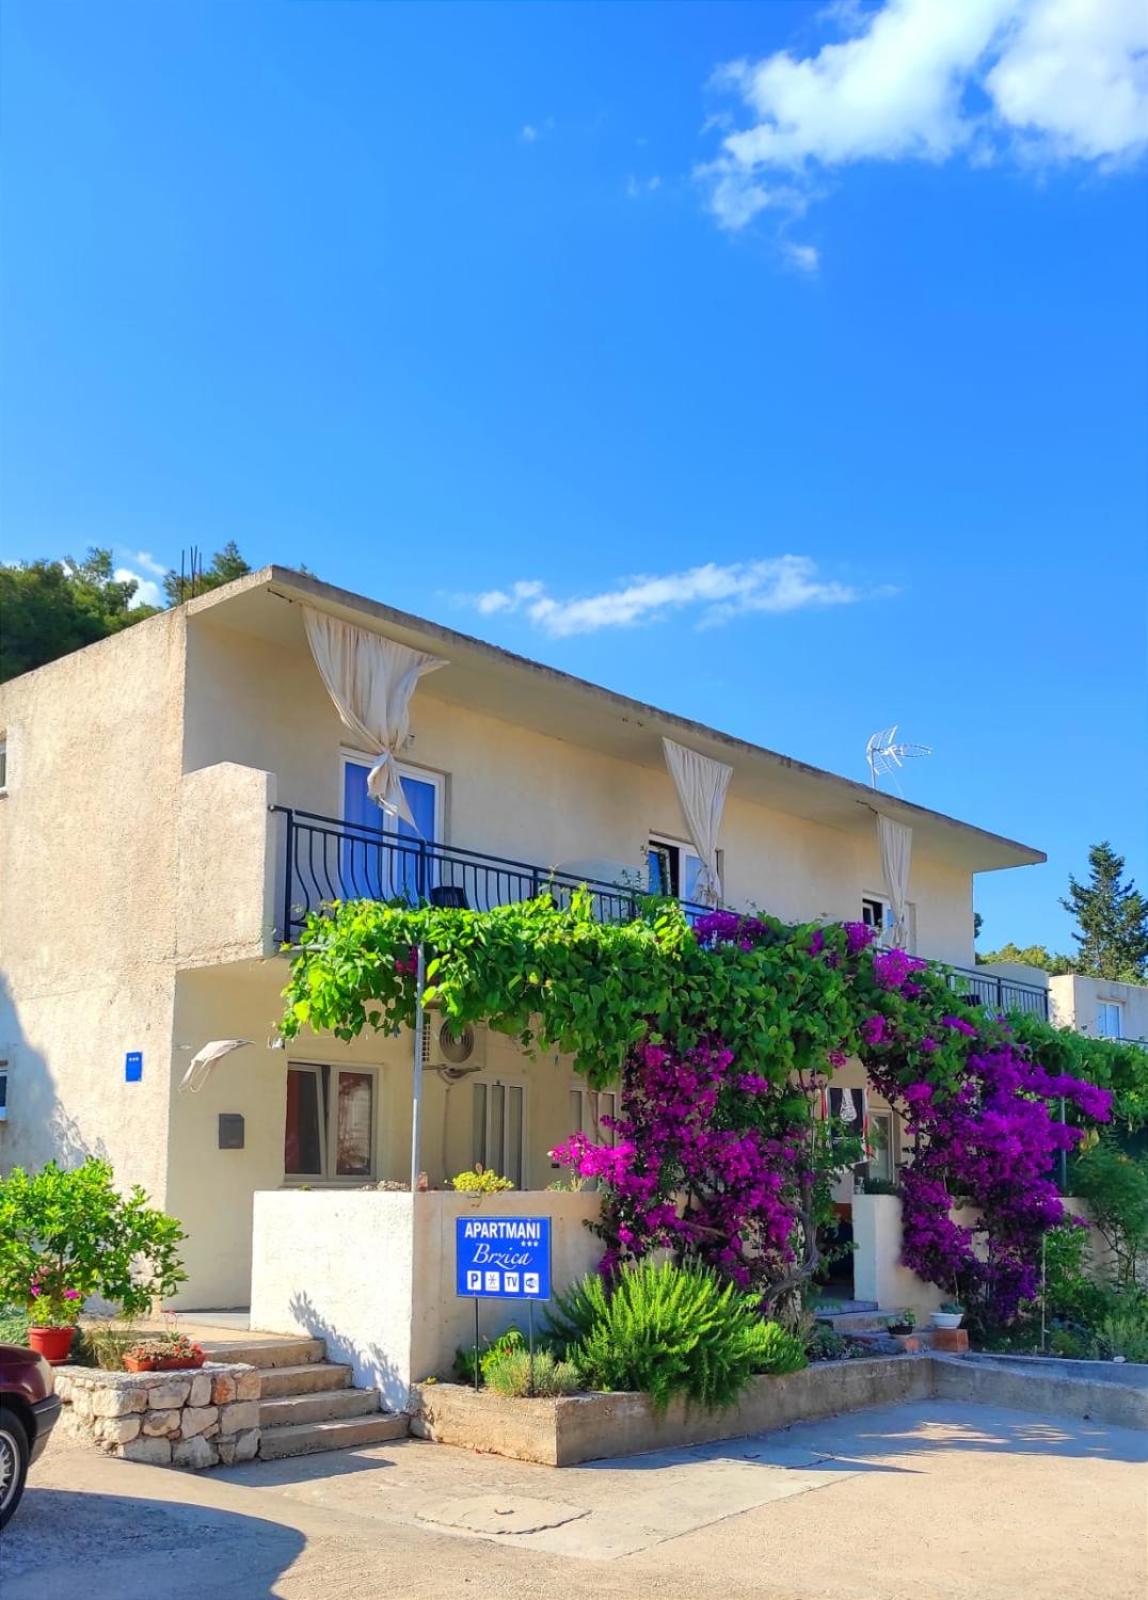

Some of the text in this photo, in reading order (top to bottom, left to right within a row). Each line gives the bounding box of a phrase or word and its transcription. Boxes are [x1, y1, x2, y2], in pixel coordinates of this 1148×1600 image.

[464, 1222, 540, 1239] APARTMANI
[472, 1243, 533, 1270] Brzica
[470, 1273, 517, 1288] P TV
